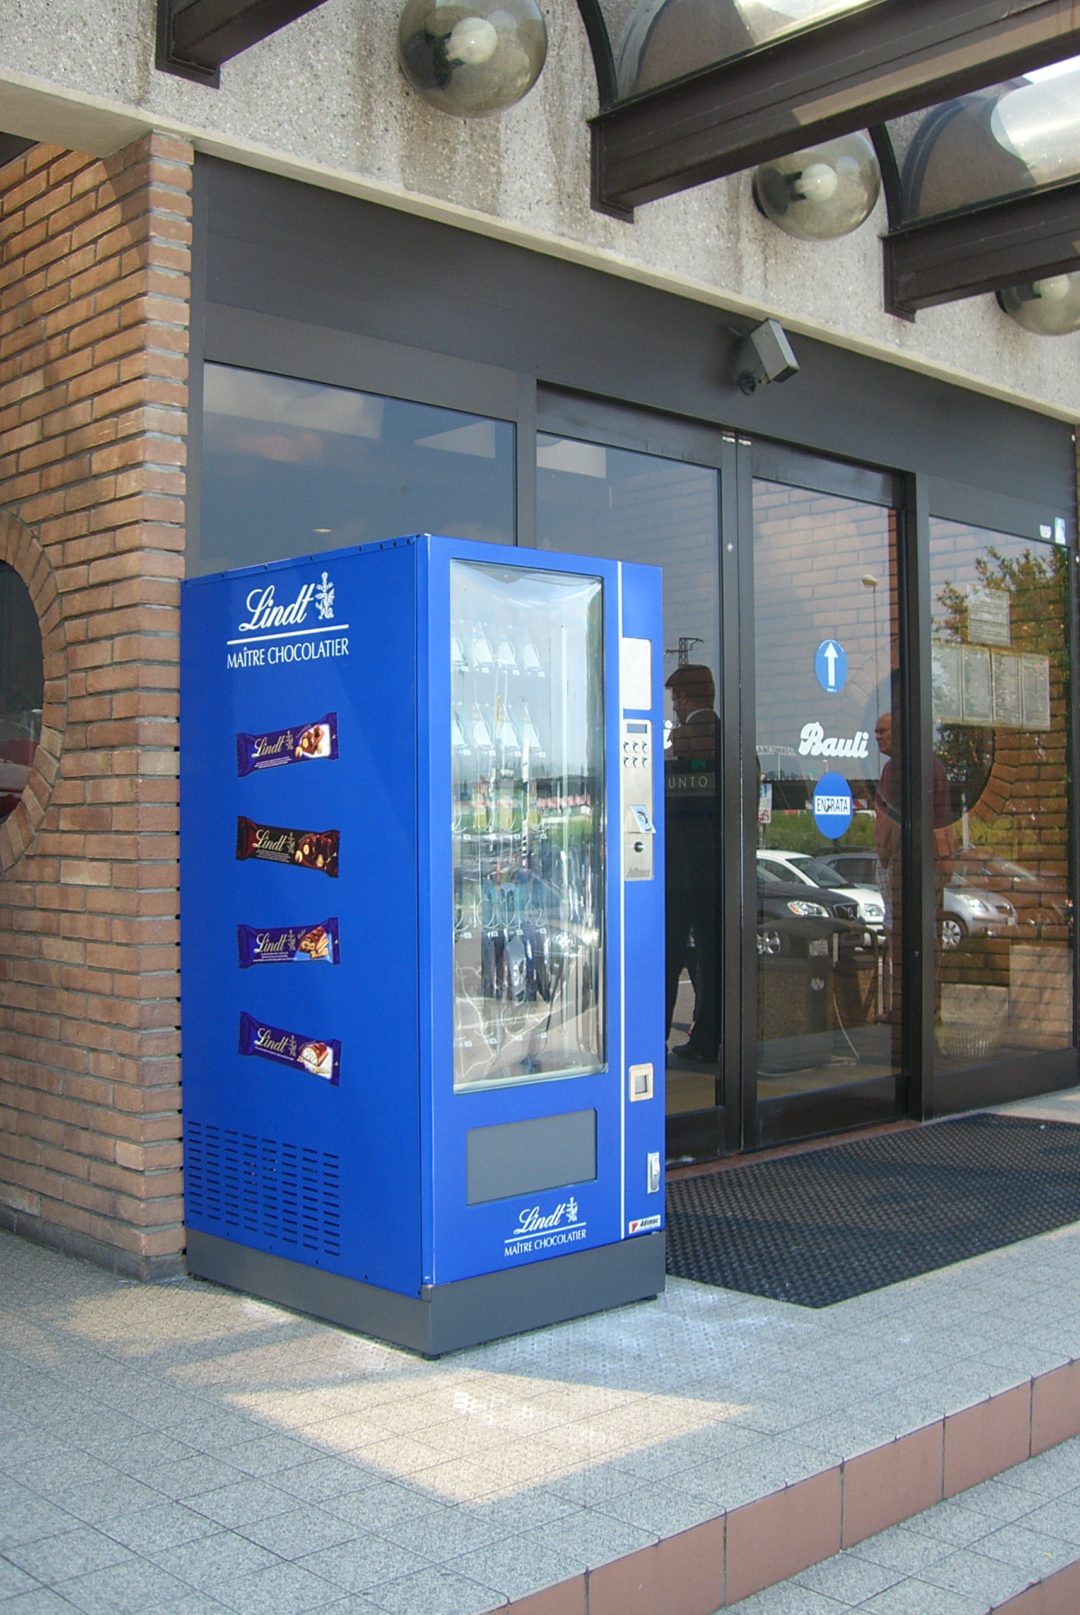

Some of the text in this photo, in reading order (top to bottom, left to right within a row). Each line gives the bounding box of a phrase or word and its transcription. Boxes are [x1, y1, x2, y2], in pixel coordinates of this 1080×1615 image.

[238, 583, 316, 631] Lindt
[227, 638, 349, 669] MAÎTRE CHOCOLATIER
[251, 735, 286, 758] Lindt
[798, 721, 869, 758] Bauli
[667, 775, 708, 788] UNTO
[816, 798, 849, 812] ENTRATA
[252, 829, 287, 851] Lindt
[253, 932, 287, 953] Lindt
[254, 1027, 289, 1053] Lindt
[513, 1202, 566, 1235] Lindt
[504, 1229, 587, 1257] MAÎTRE CHOCOLATIER
